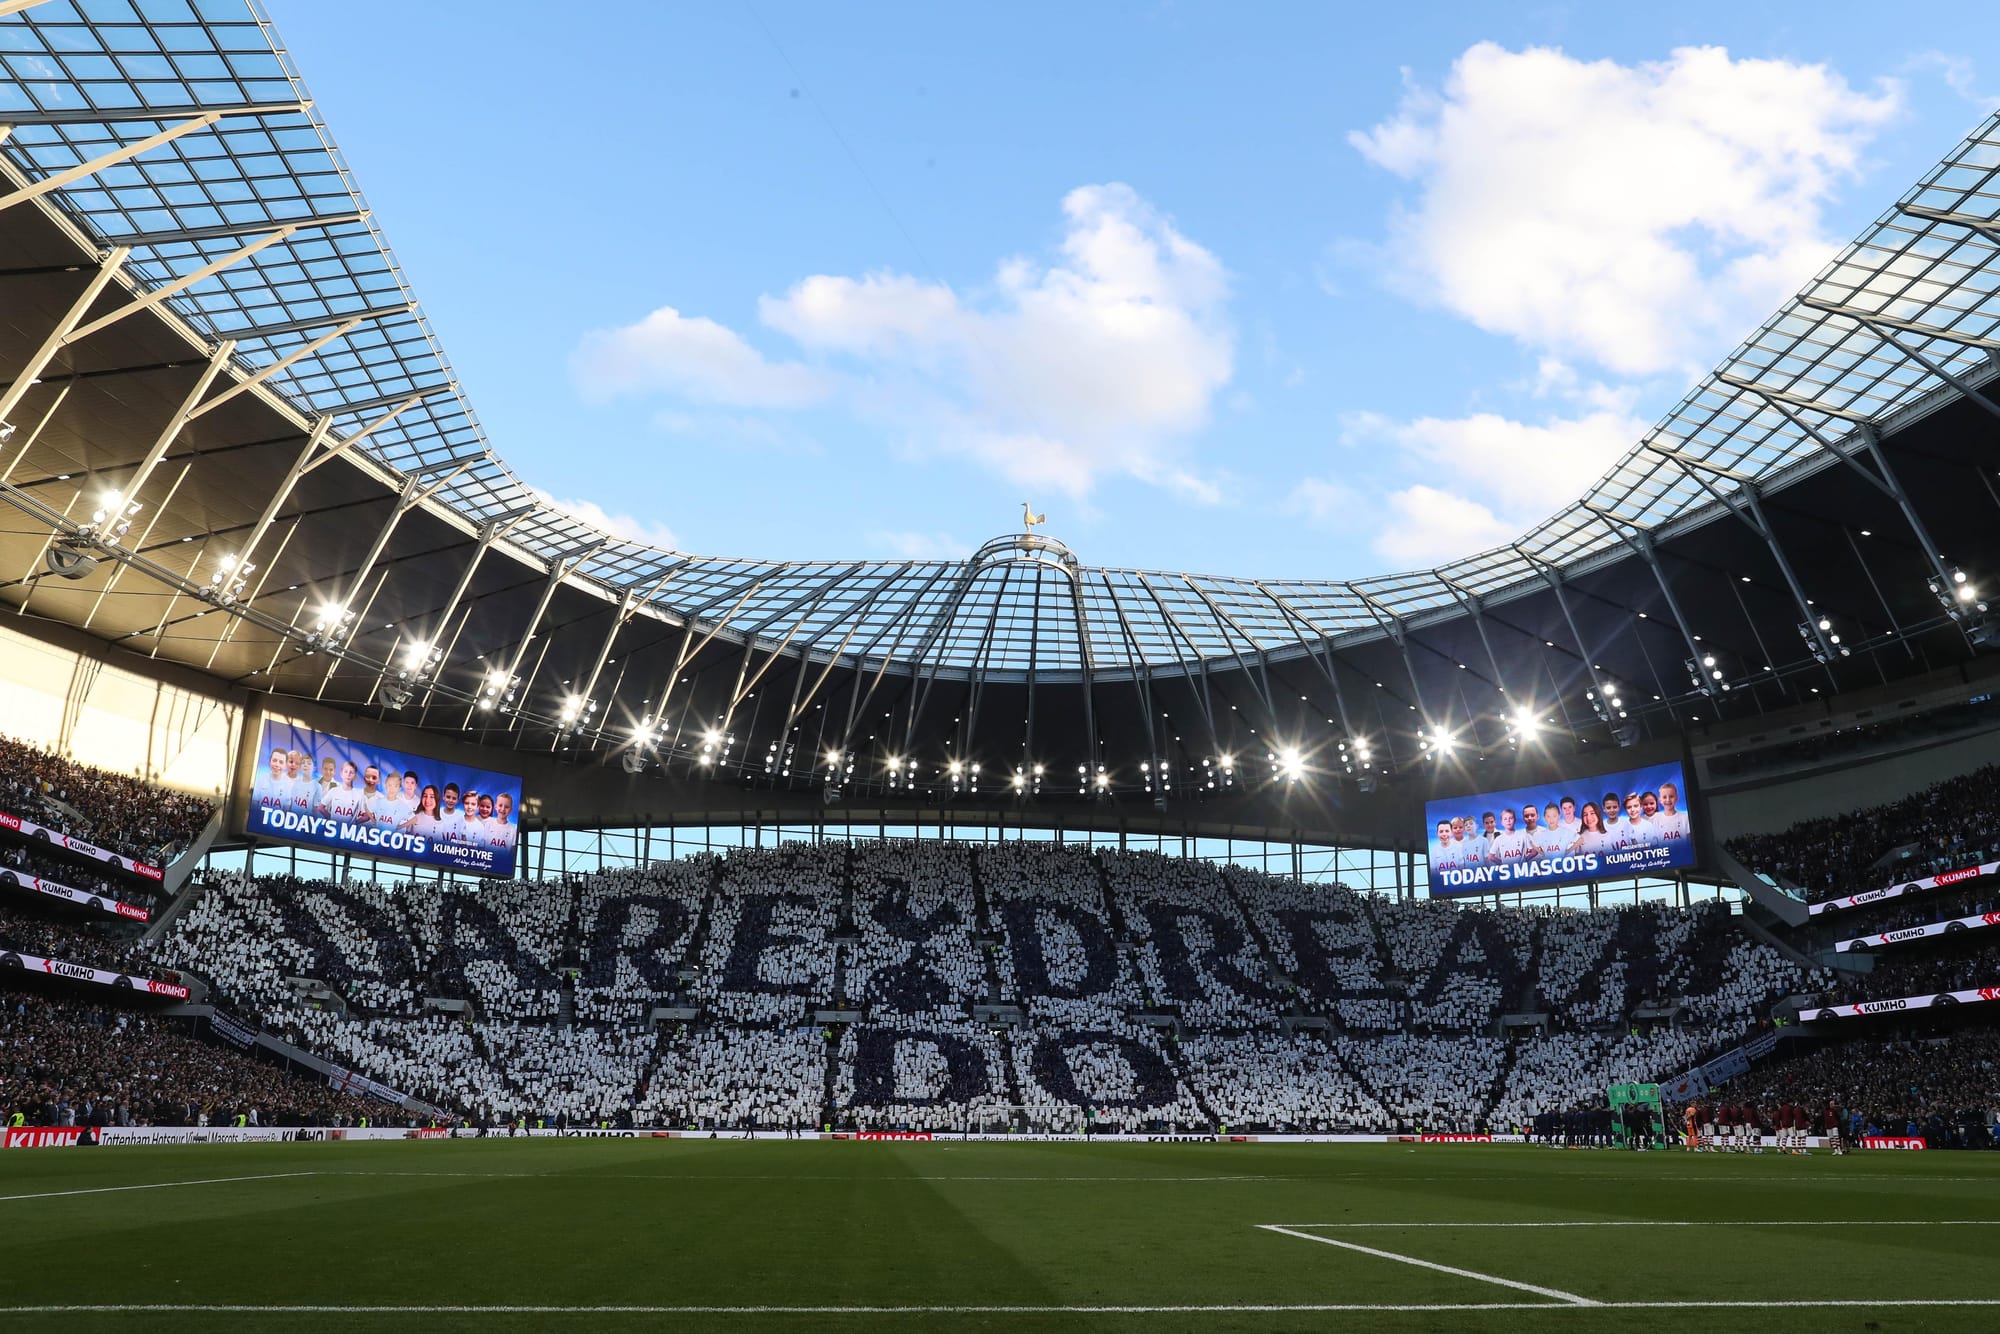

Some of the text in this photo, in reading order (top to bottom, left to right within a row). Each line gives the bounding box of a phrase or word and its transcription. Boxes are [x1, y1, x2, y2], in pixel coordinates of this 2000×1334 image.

[261, 796, 281, 808] AIA
[335, 806, 353, 817] AIA
[379, 815, 393, 824] AIA
[261, 806, 426, 853] TODAY'S MASCOTS
[1664, 831, 1681, 840] AIA
[69, 839, 96, 856] KUMHO
[491, 838, 506, 848] AIA
[433, 843, 469, 857] KUMHO
[470, 848, 493, 861] TYRE
[1504, 849, 1522, 858] AIA
[1606, 851, 1643, 865] KUMHO
[1644, 847, 1670, 859] TYRE
[138, 865, 162, 879] KUMHO
[1440, 853, 1598, 886] TODAY'S MASCOTS
[1942, 869, 1977, 883] KUMHO
[41, 882, 73, 898] KUMHO
[1856, 890, 1886, 903] KUMHO
[121, 906, 147, 919] KUMHO
[1889, 928, 1925, 941] KUMHO
[54, 962, 95, 980] KUMHO
[155, 982, 187, 997] KUMHO
[1864, 1000, 1907, 1013] KUMHO
[851, 1027, 1180, 1107] DO
[102, 1131, 150, 1145] Tottenham
